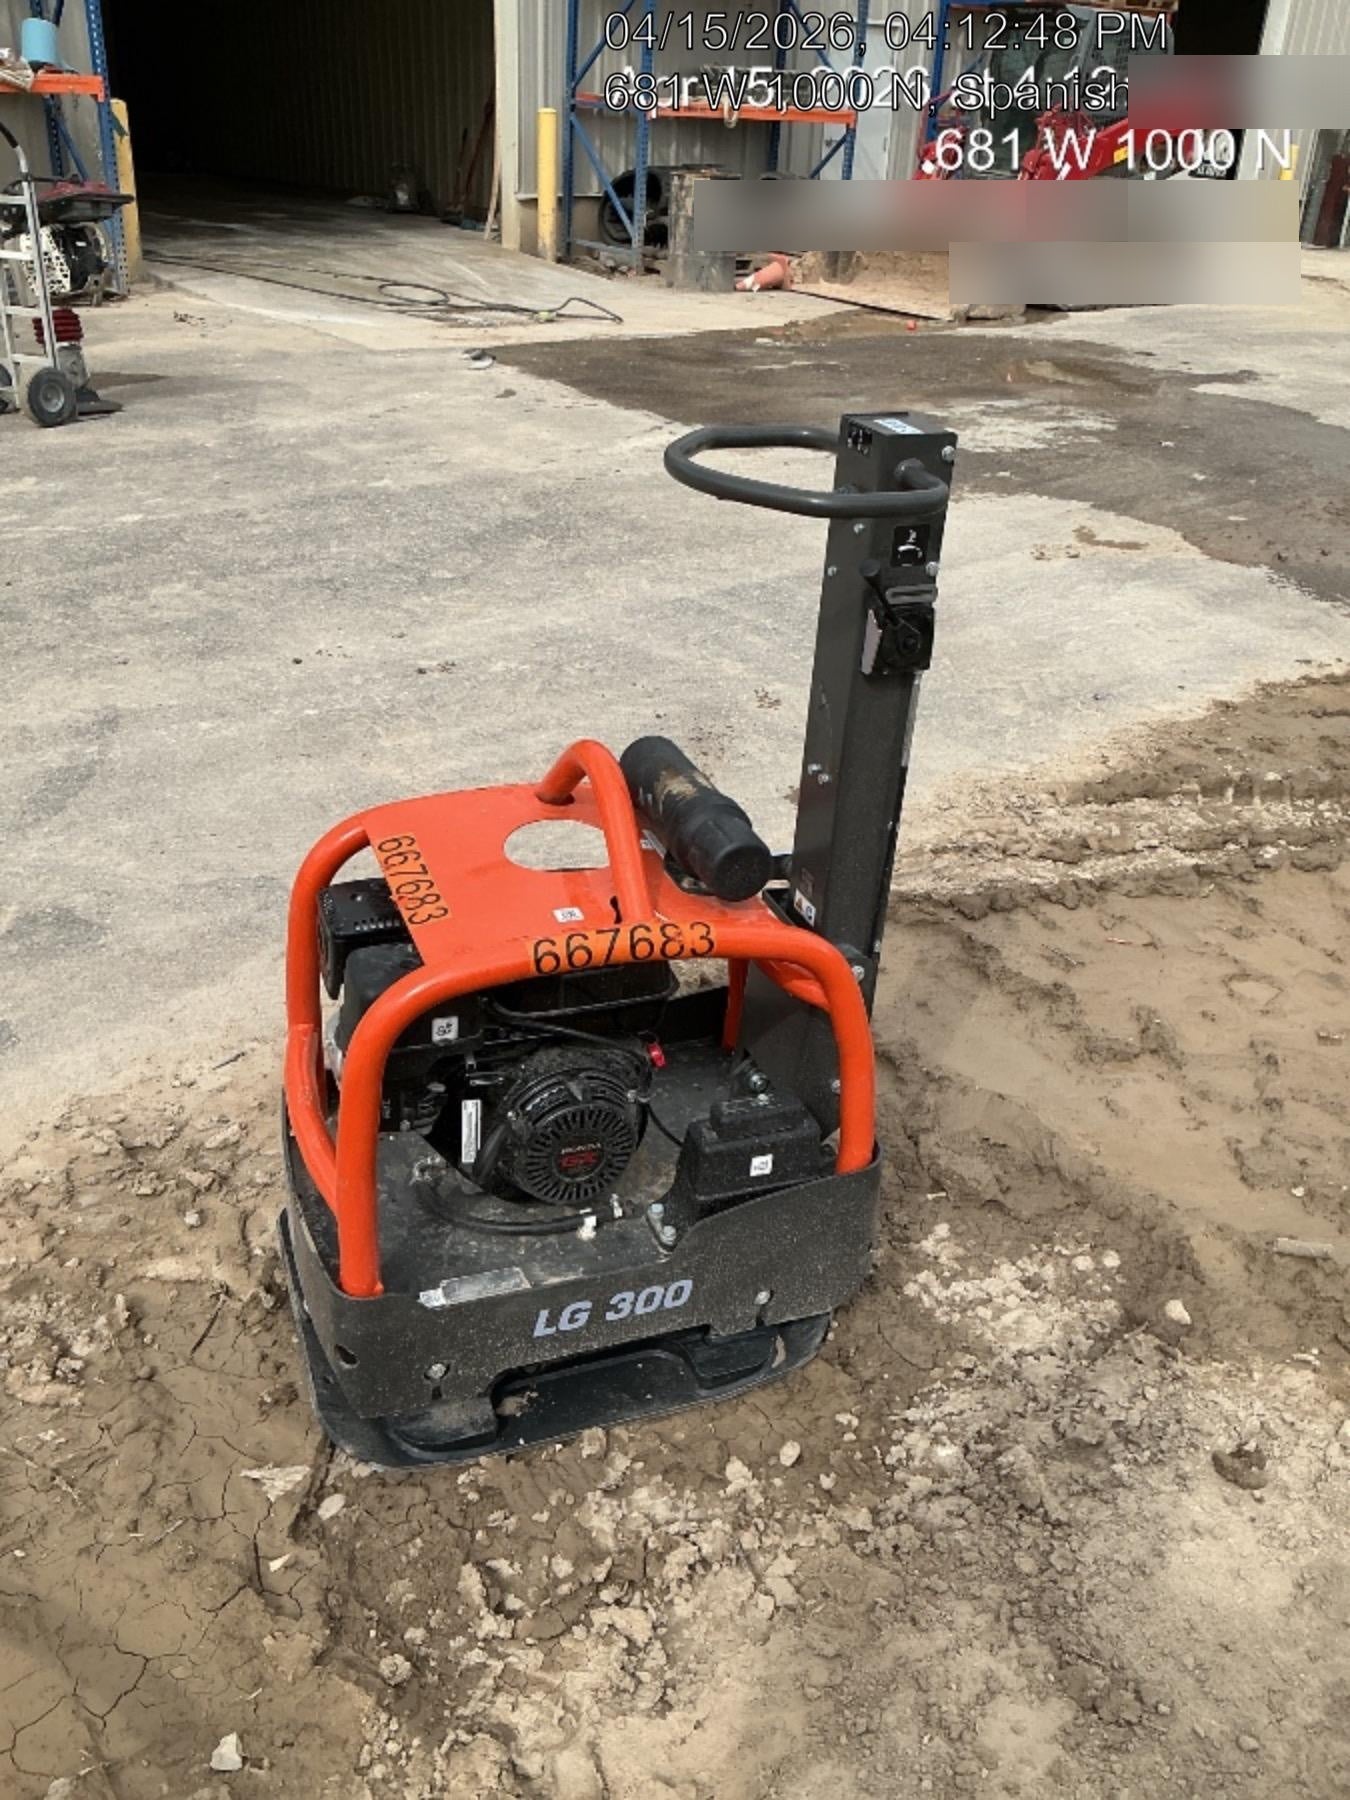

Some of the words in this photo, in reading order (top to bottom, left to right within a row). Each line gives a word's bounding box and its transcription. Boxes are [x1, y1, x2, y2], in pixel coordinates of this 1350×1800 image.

[378, 835, 449, 925] 667683
[533, 921, 715, 976] 667683
[533, 1300, 593, 1338] LG
[605, 1279, 693, 1321] 300
